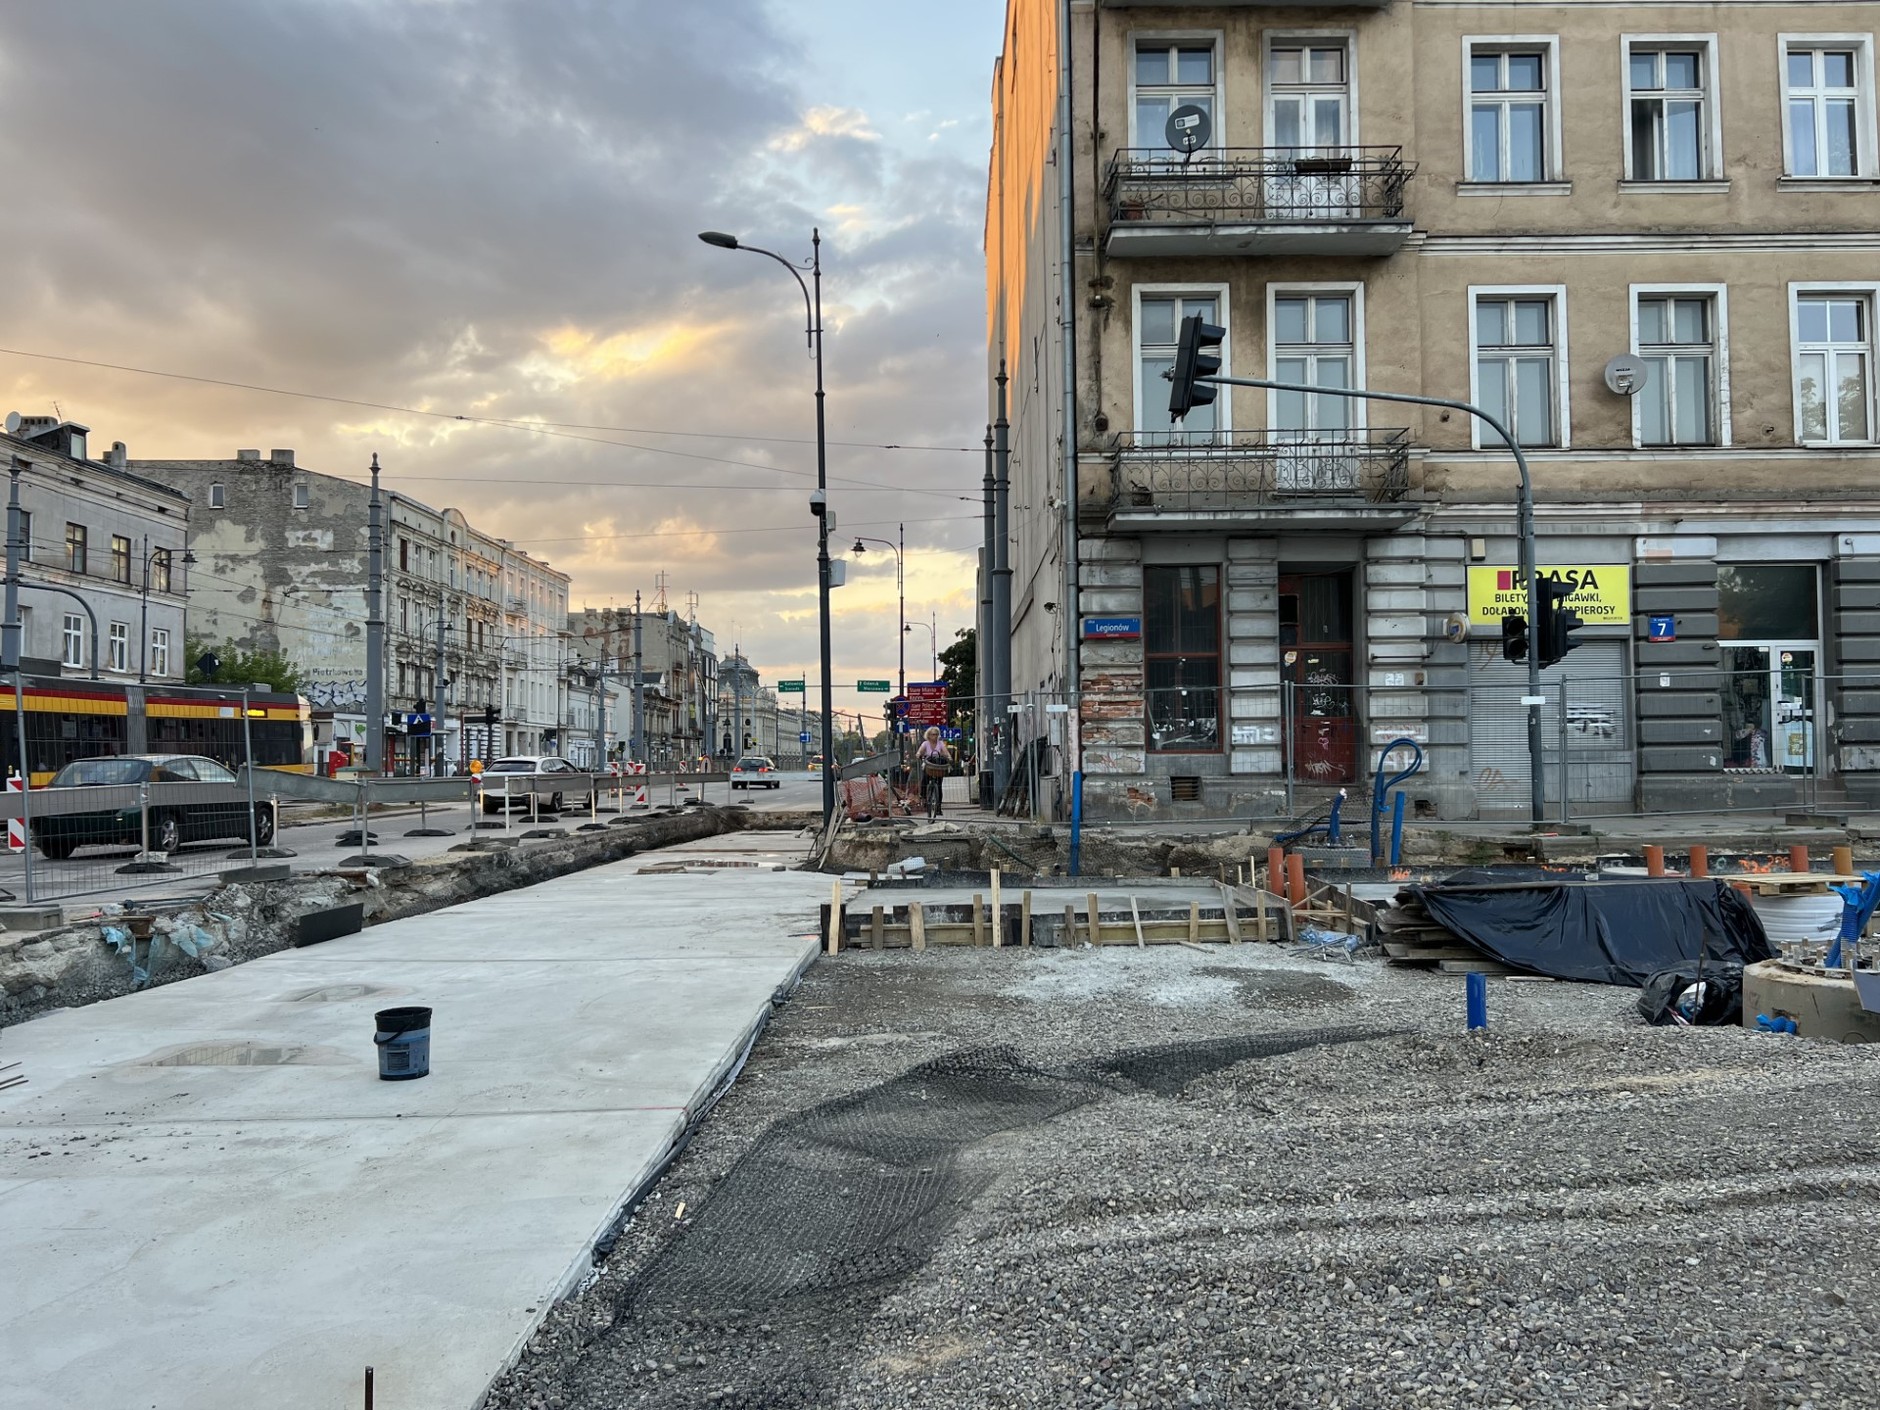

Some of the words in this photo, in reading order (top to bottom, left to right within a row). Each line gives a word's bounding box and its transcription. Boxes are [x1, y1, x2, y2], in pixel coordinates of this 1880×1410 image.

[1556, 593, 1602, 603] IGAWKI,
[1096, 623, 1129, 633] Legionów
[1657, 623, 1666, 636] 7
